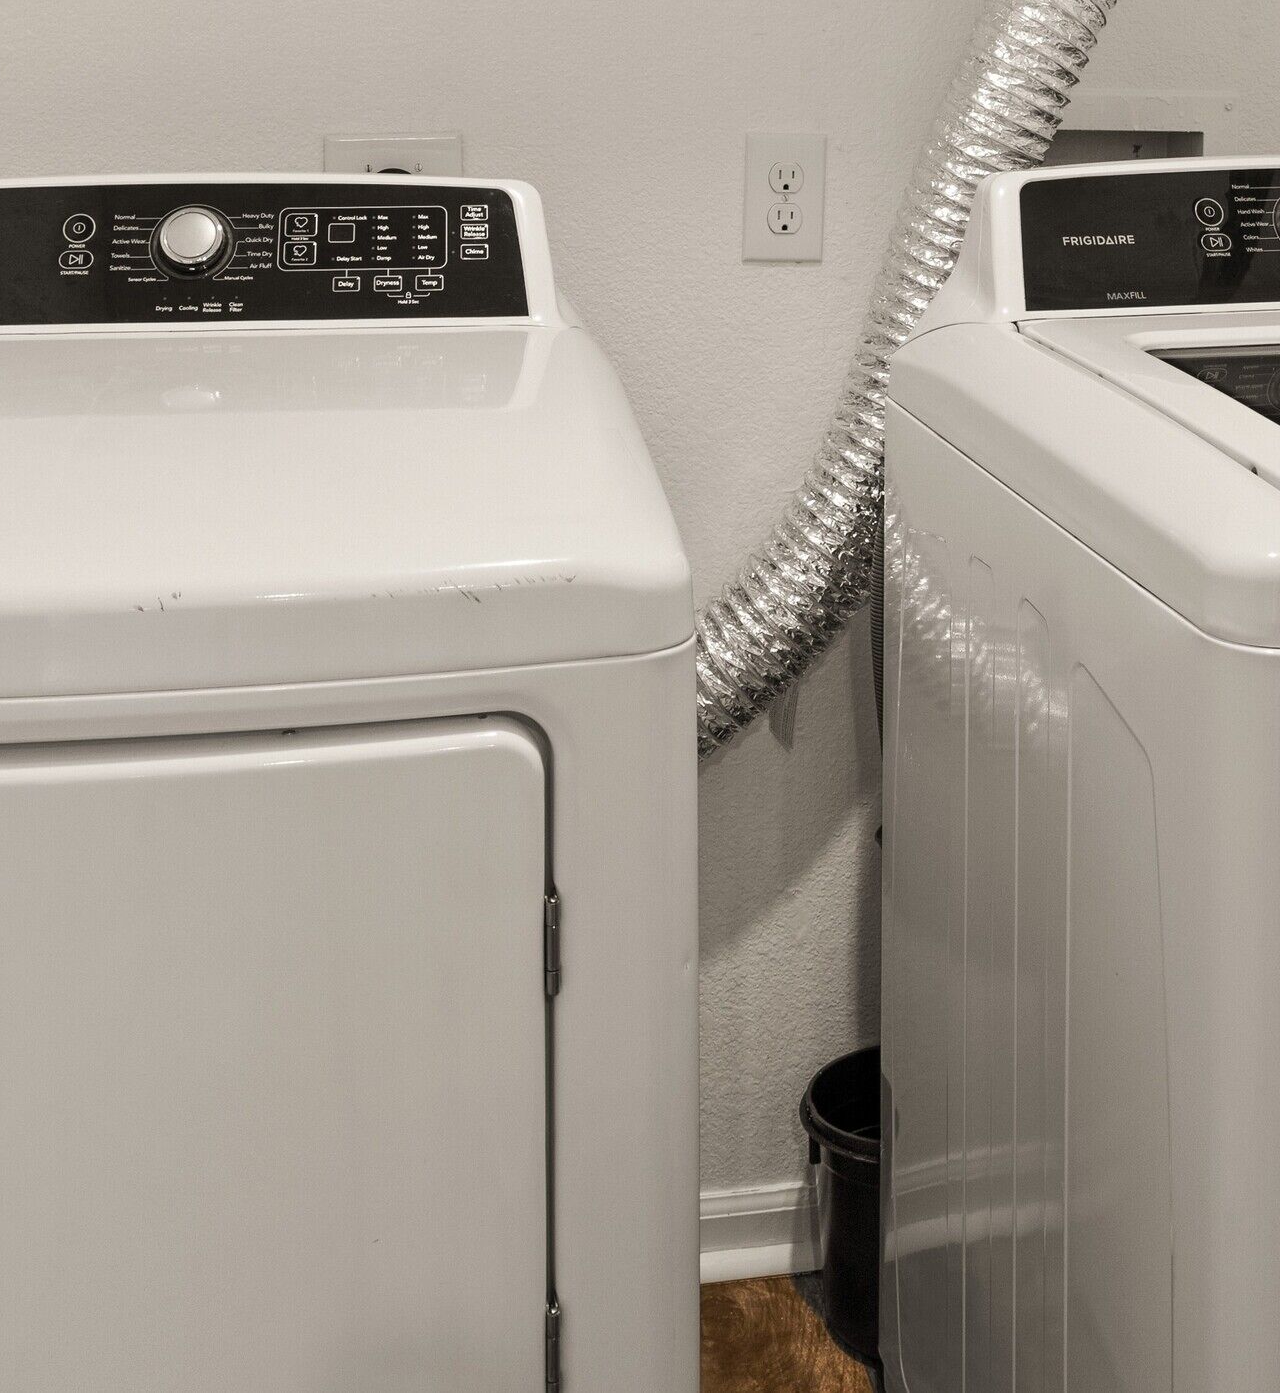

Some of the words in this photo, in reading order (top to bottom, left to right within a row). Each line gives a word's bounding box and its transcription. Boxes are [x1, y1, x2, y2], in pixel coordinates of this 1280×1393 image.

[262, 236, 273, 244] Dry
[1062, 234, 1135, 246] FRIGIDAIRE
[421, 279, 438, 287] Temp
[1106, 291, 1147, 300] MAXFILL
